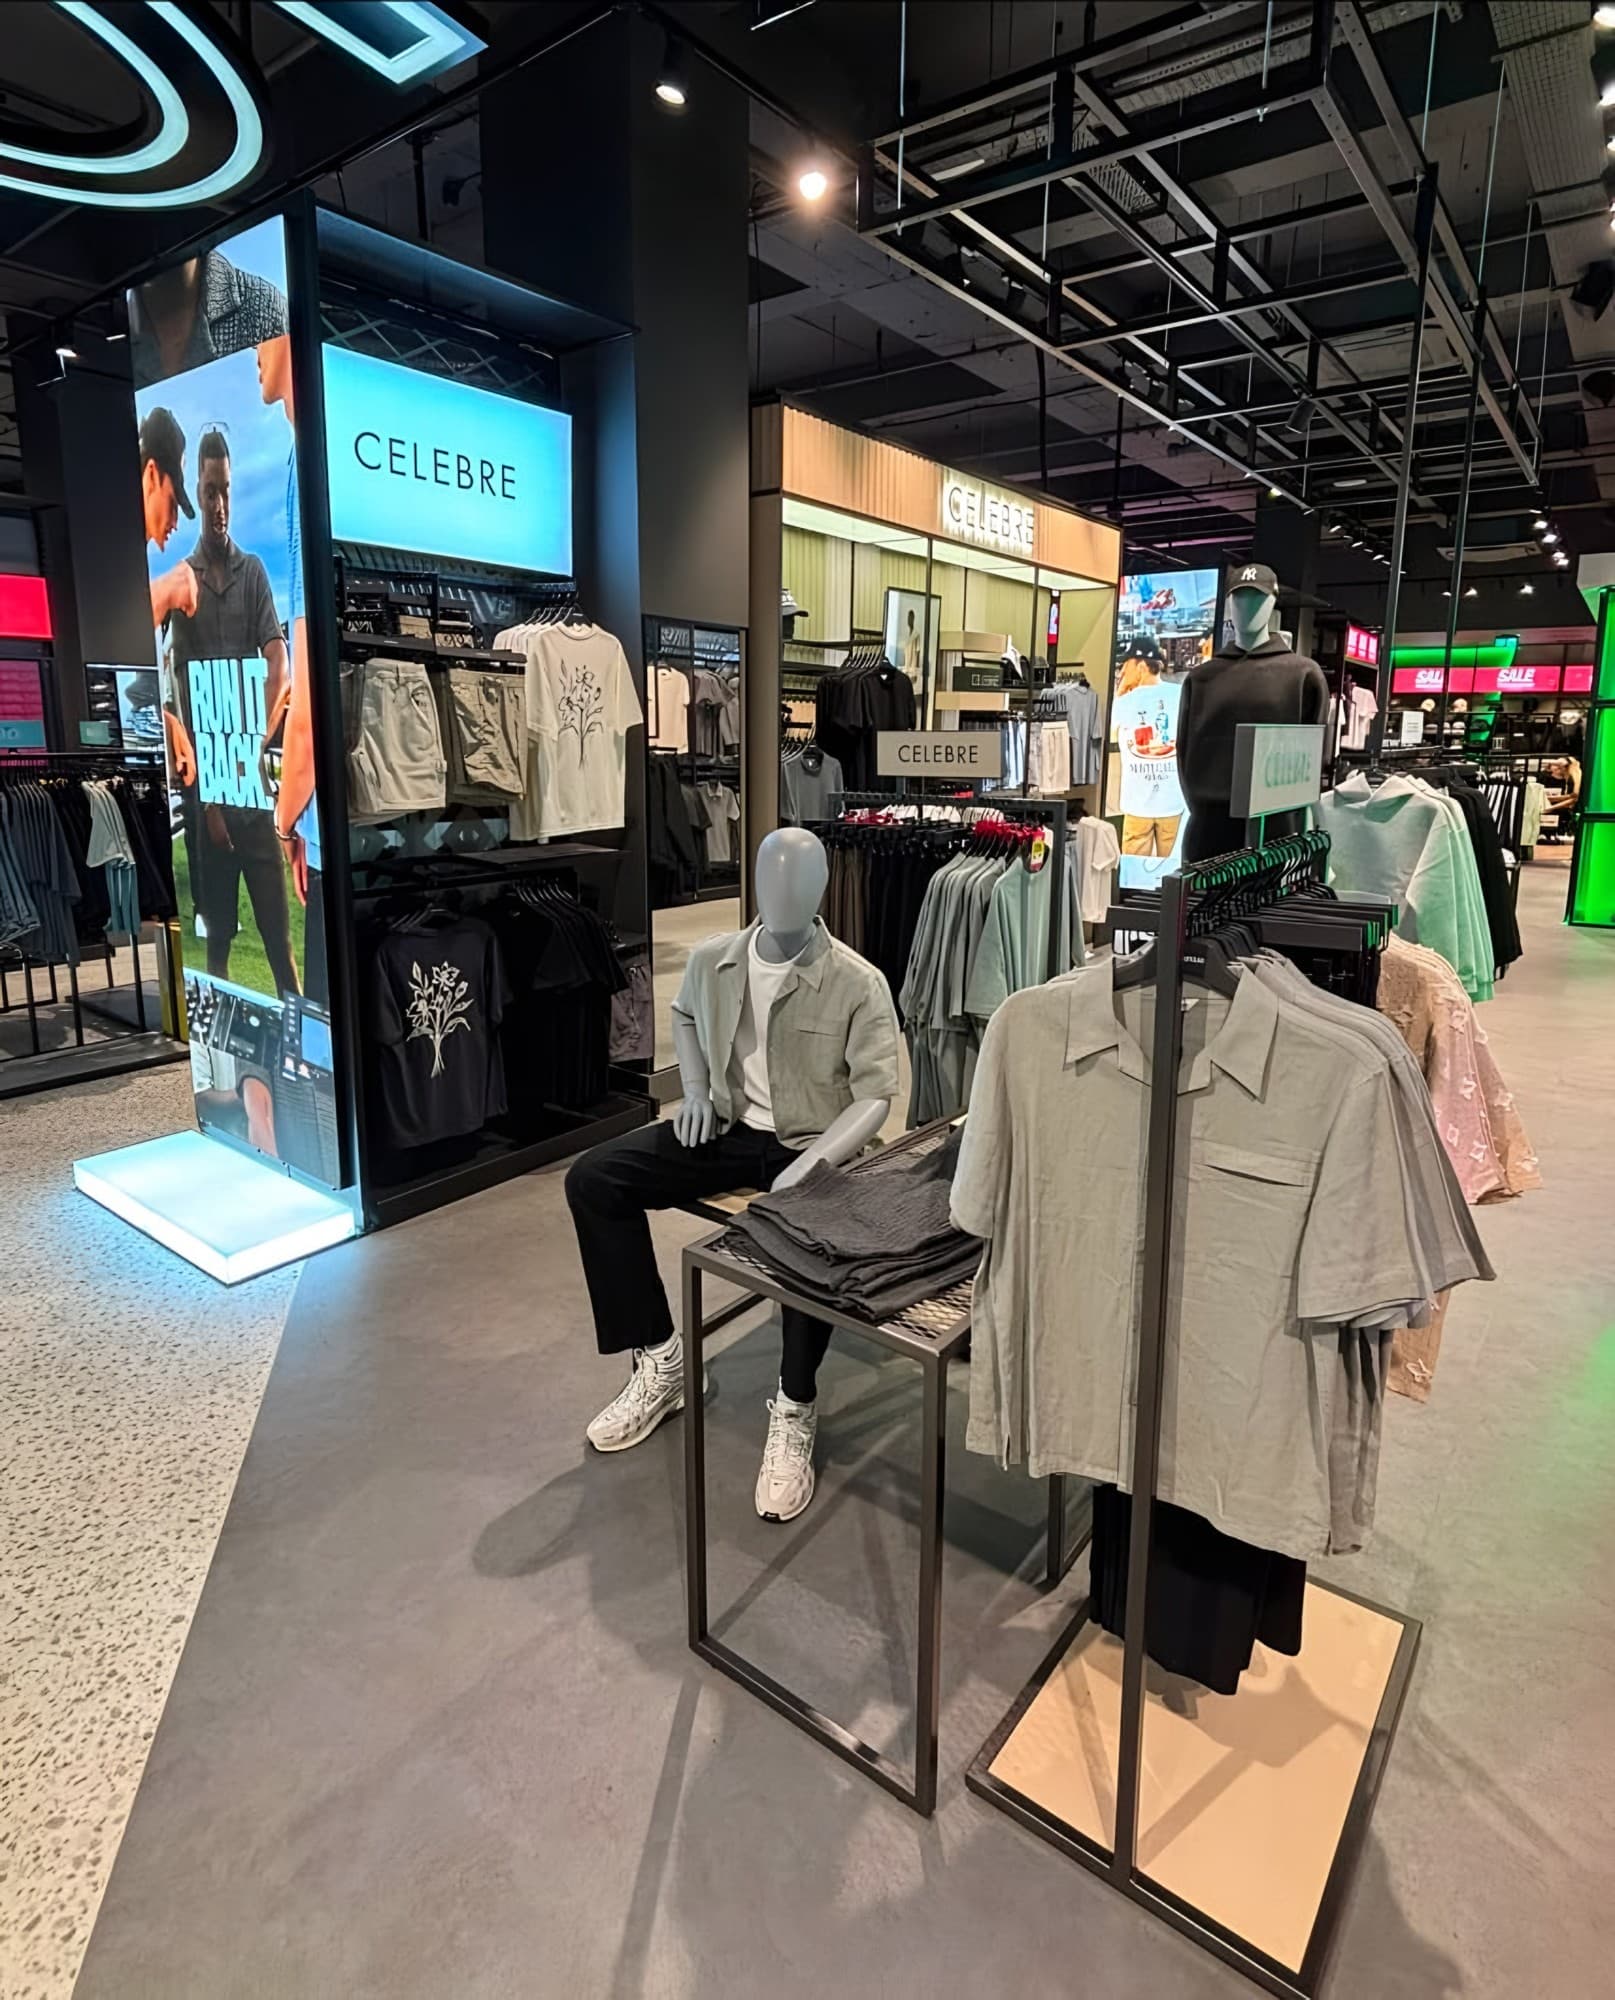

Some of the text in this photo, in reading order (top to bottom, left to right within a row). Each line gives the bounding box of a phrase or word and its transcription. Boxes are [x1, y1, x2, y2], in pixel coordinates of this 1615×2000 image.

[354, 431, 516, 500] CELEBRE
[949, 486, 1034, 545] CELEBRE
[1415, 668, 1444, 682] SAL
[1498, 667, 1536, 683] SALE
[188, 657, 268, 736] RUN IT
[898, 744, 979, 764] CELEBRE
